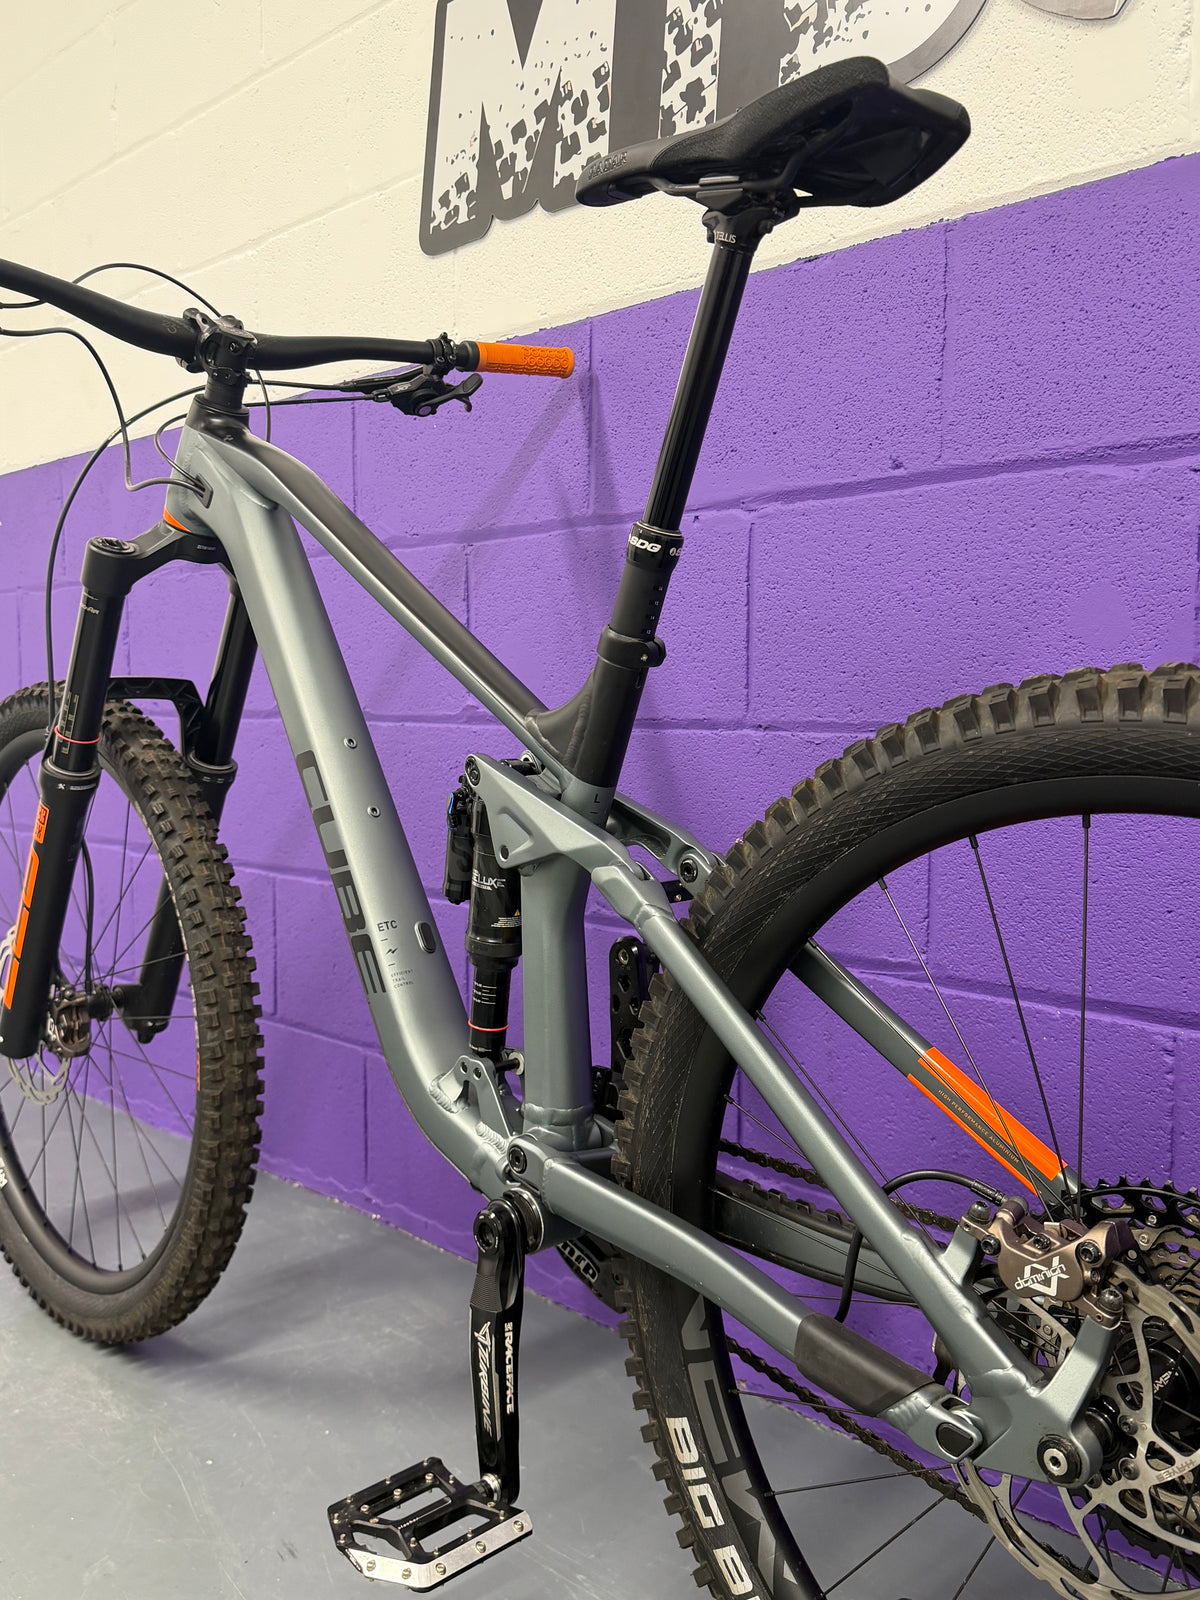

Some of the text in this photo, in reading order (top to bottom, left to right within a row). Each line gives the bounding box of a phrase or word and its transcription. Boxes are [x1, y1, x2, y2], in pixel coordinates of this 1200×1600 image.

[630, 535, 662, 553] SDG
[594, 793, 601, 804] L
[296, 750, 387, 995] CUBE
[377, 920, 398, 932] ETC
[938, 1089, 1020, 1164] HIGH PERFORMANCE ALUMINIUM
[477, 1340, 493, 1439] TURBINE
[665, 1416, 761, 1600] BIG B
